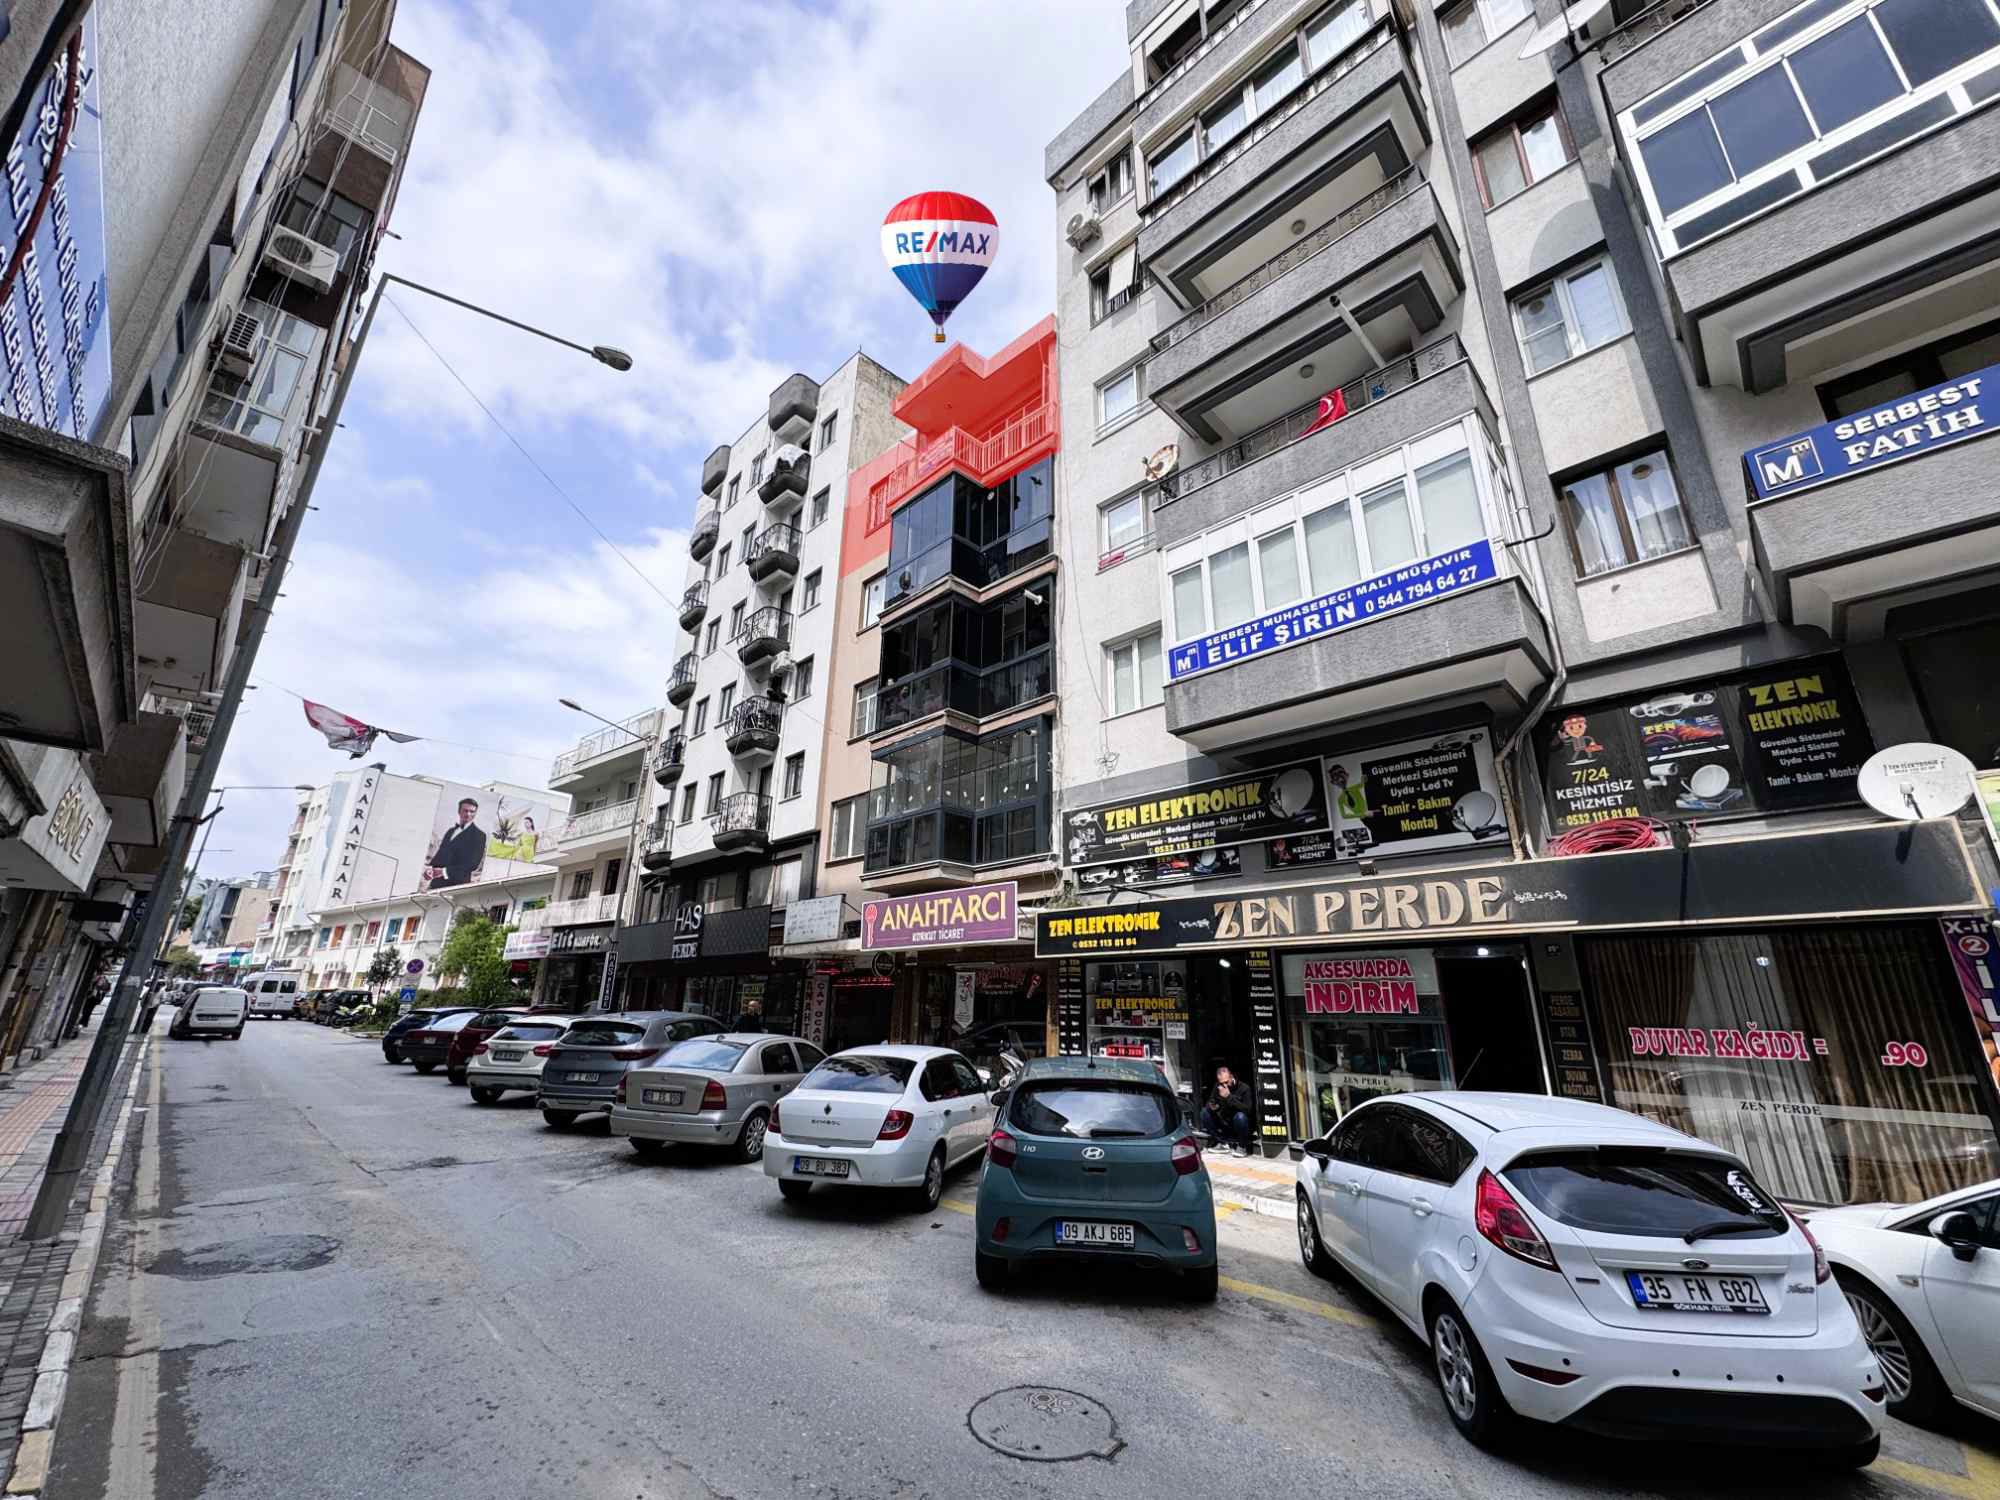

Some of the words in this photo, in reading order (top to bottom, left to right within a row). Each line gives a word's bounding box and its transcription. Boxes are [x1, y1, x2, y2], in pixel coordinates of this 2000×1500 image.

[51, 172, 73, 250] AYDIN
[896, 232, 990, 255] RE/MAX
[1834, 378, 1982, 440] SERBEST
[1843, 405, 1985, 465] FATİH
[1207, 632, 1264, 664] ELİF
[1274, 602, 1356, 645] ŞİRİN
[1365, 599, 1374, 614] 0
[1377, 592, 1403, 609] 544
[1406, 582, 1433, 601] 794
[1436, 573, 1456, 590] 64
[1460, 565, 1479, 583] 27
[1205, 624, 1259, 647] SERBEST
[1749, 675, 1823, 706] ZEN
[1749, 700, 1840, 732] ELEKTRONİK
[1371, 761, 1413, 777] Güvenlik
[1414, 748, 1467, 768] Sistemleri
[1382, 771, 1421, 786] Merkezi
[1423, 765, 1458, 780] Sistem
[1572, 767, 1609, 784] 7/24
[1390, 785, 1415, 799] Uydu
[1422, 779, 1441, 793] Led
[1442, 777, 1454, 789] Tv
[1556, 778, 1635, 800] KESİNTİSİZ
[1104, 807, 1137, 831] ZEN
[1140, 782, 1263, 825] ELEKTRONİK
[1382, 803, 1410, 817] Tamir
[1418, 796, 1451, 811] Bakım
[1570, 794, 1623, 811] HİZMET
[1401, 817, 1438, 833] Montaj
[1567, 812, 1591, 826] 0532
[332, 777, 373, 900] SARANLAR
[673, 904, 702, 931] HAS
[881, 890, 1007, 931] ANAHTARCI
[1213, 896, 1296, 939] ZEN
[1313, 876, 1509, 935] PERDE
[1049, 918, 1072, 937] ZEN
[1074, 911, 1160, 935] ELEKTRONİK
[1304, 959, 1413, 979] AKSESUARDA
[1304, 980, 1420, 1014] İNDİRİM
[1629, 1027, 1710, 1056] DUVAR
[1711, 1021, 1811, 1061] KAĞIDI
[1740, 1101, 1767, 1112] ZEN
[1773, 1102, 1822, 1116] PERDE
[800, 1159, 810, 1170] 09
[1065, 1223, 1079, 1239] 09
[1084, 1225, 1105, 1241] AKJ
[1110, 1226, 1132, 1241] 685
[1643, 1277, 1672, 1300] 35
[1684, 1279, 1713, 1301] FN
[1719, 1281, 1760, 1304] 682
